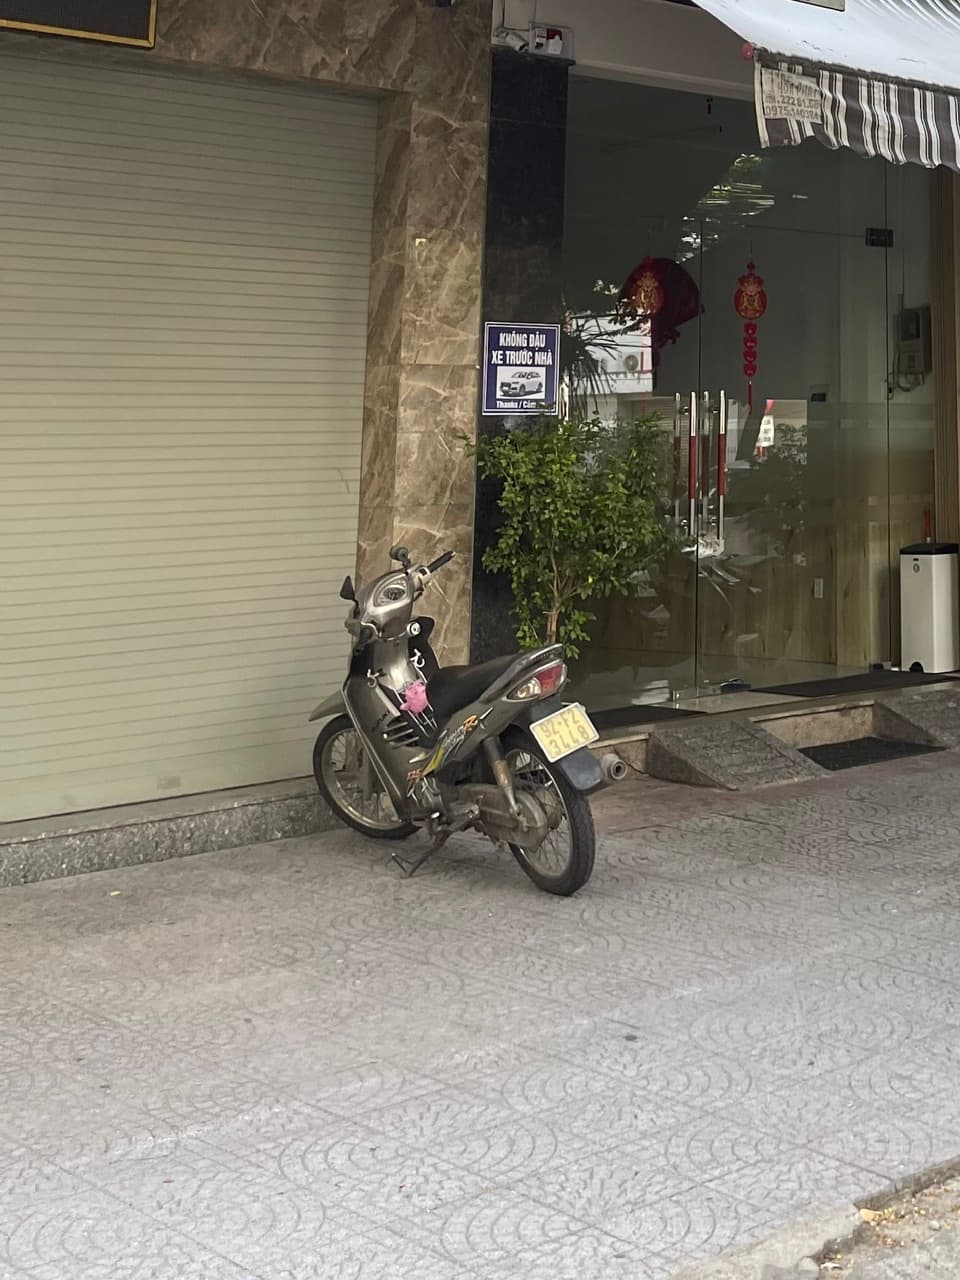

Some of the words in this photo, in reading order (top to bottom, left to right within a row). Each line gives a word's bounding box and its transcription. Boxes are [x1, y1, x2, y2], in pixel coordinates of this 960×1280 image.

[499, 330, 527, 347] KHÔNG
[491, 350, 503, 365] XE
[505, 348, 533, 365] TRƯỚC
[534, 349, 552, 365] NHÀ
